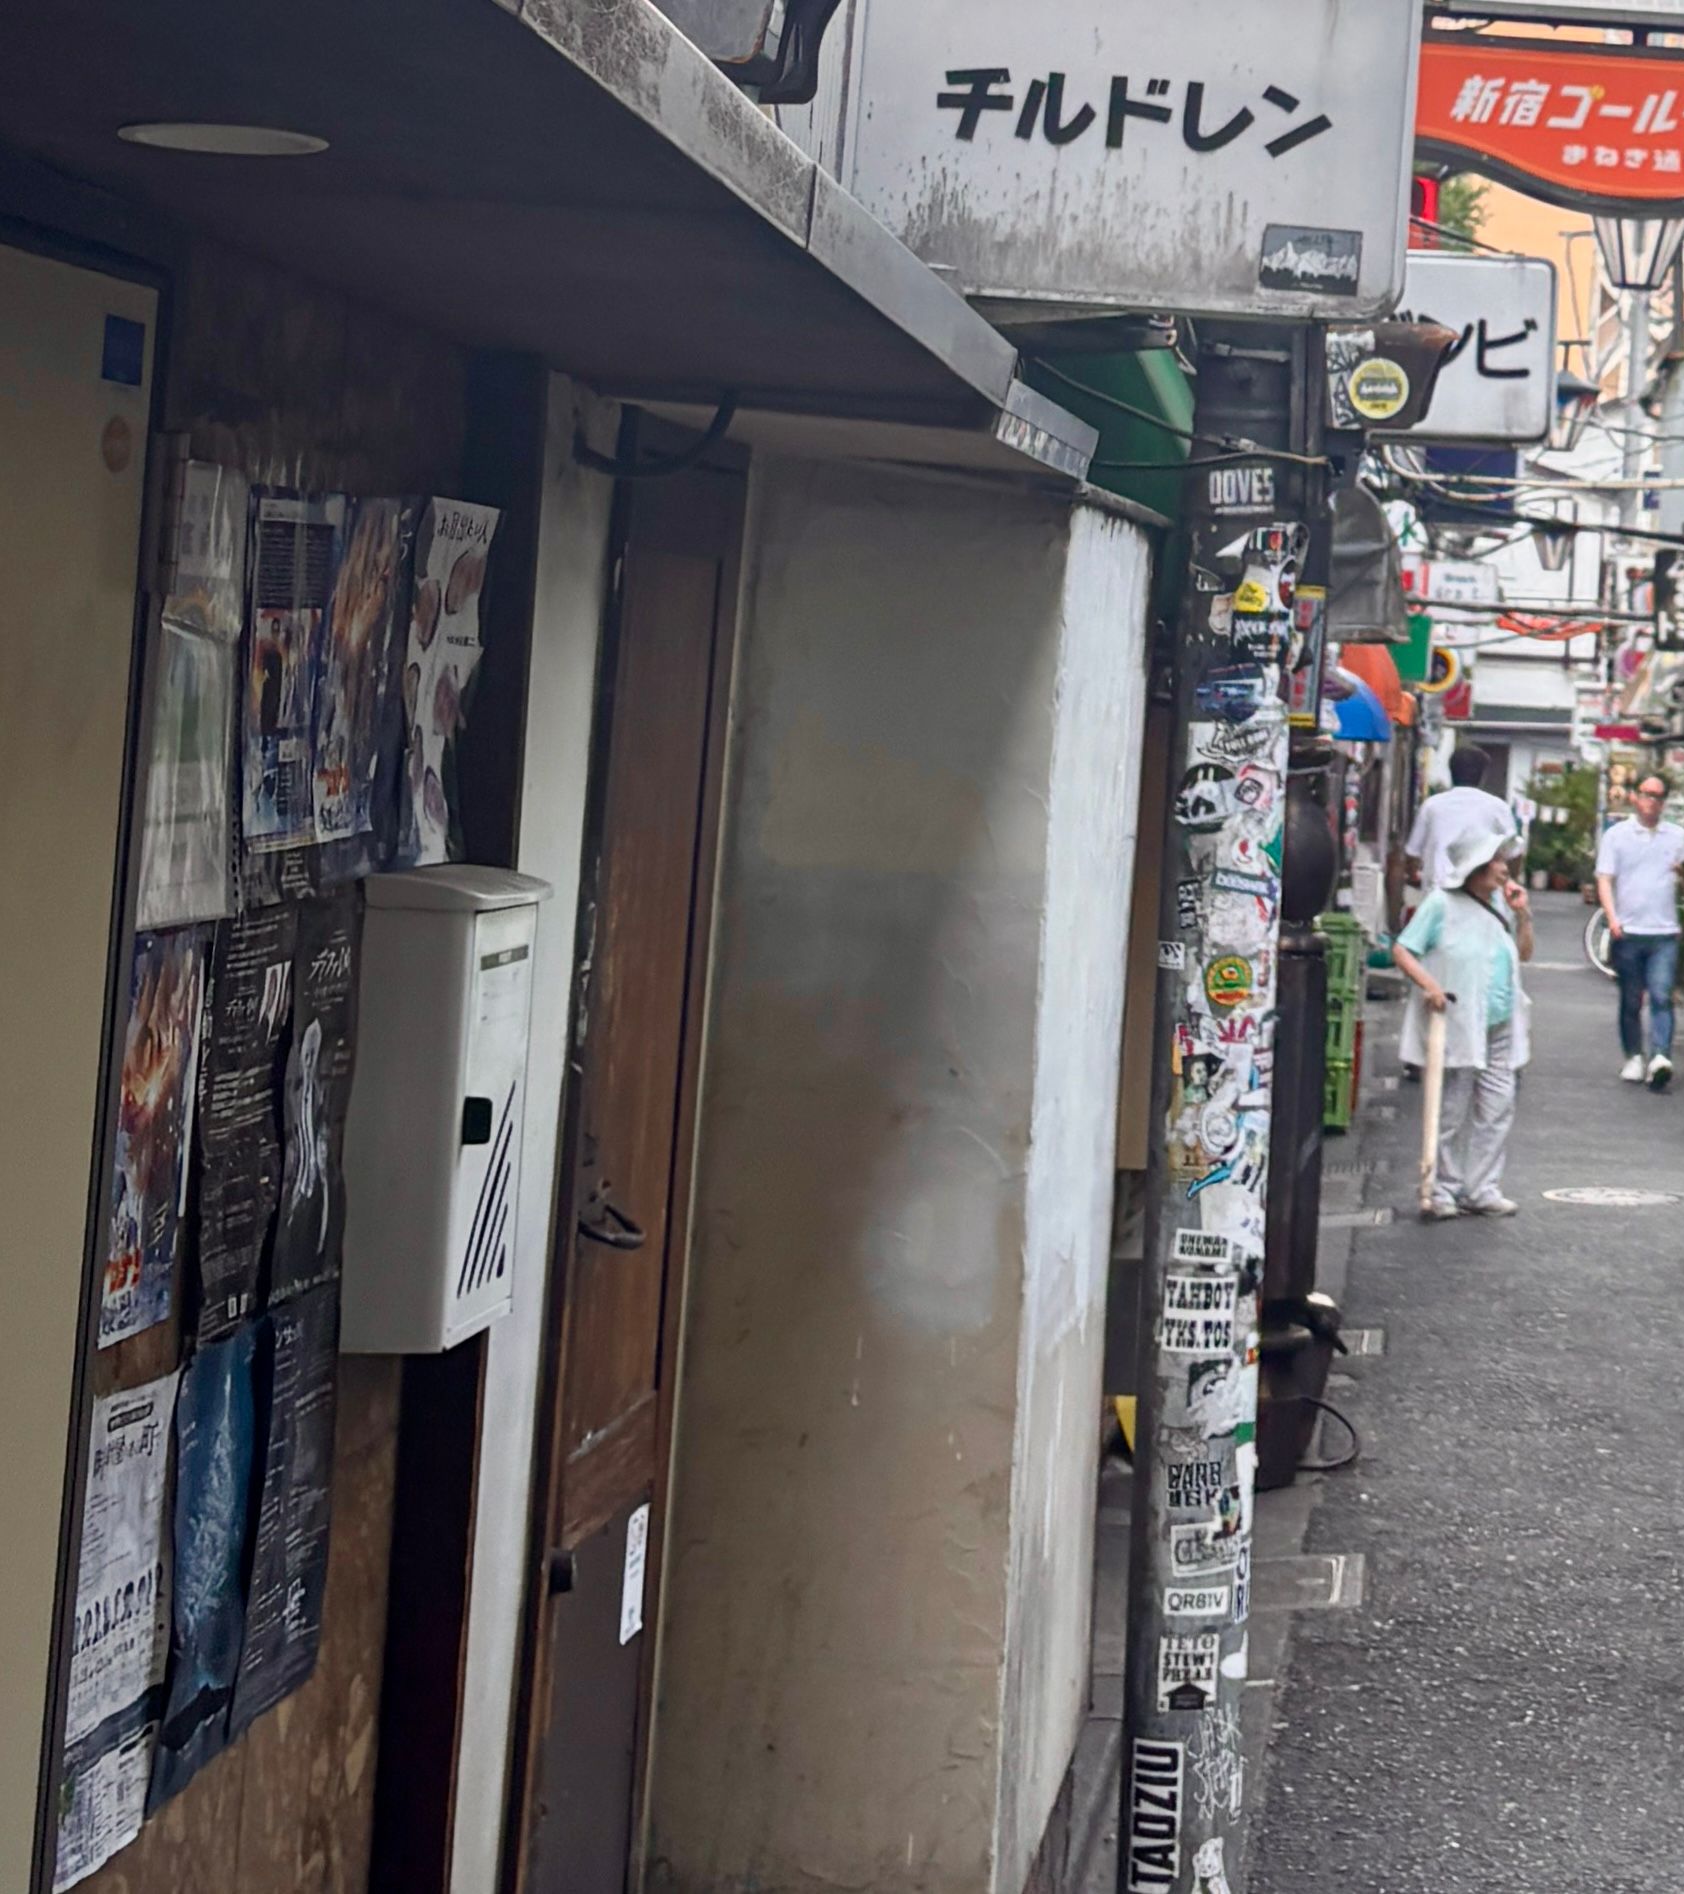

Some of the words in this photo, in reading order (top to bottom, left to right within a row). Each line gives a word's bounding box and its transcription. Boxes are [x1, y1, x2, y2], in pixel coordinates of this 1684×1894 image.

[936, 67, 1333, 158] チルドレン
[1130, 1745, 1179, 1888] TAOZIU
